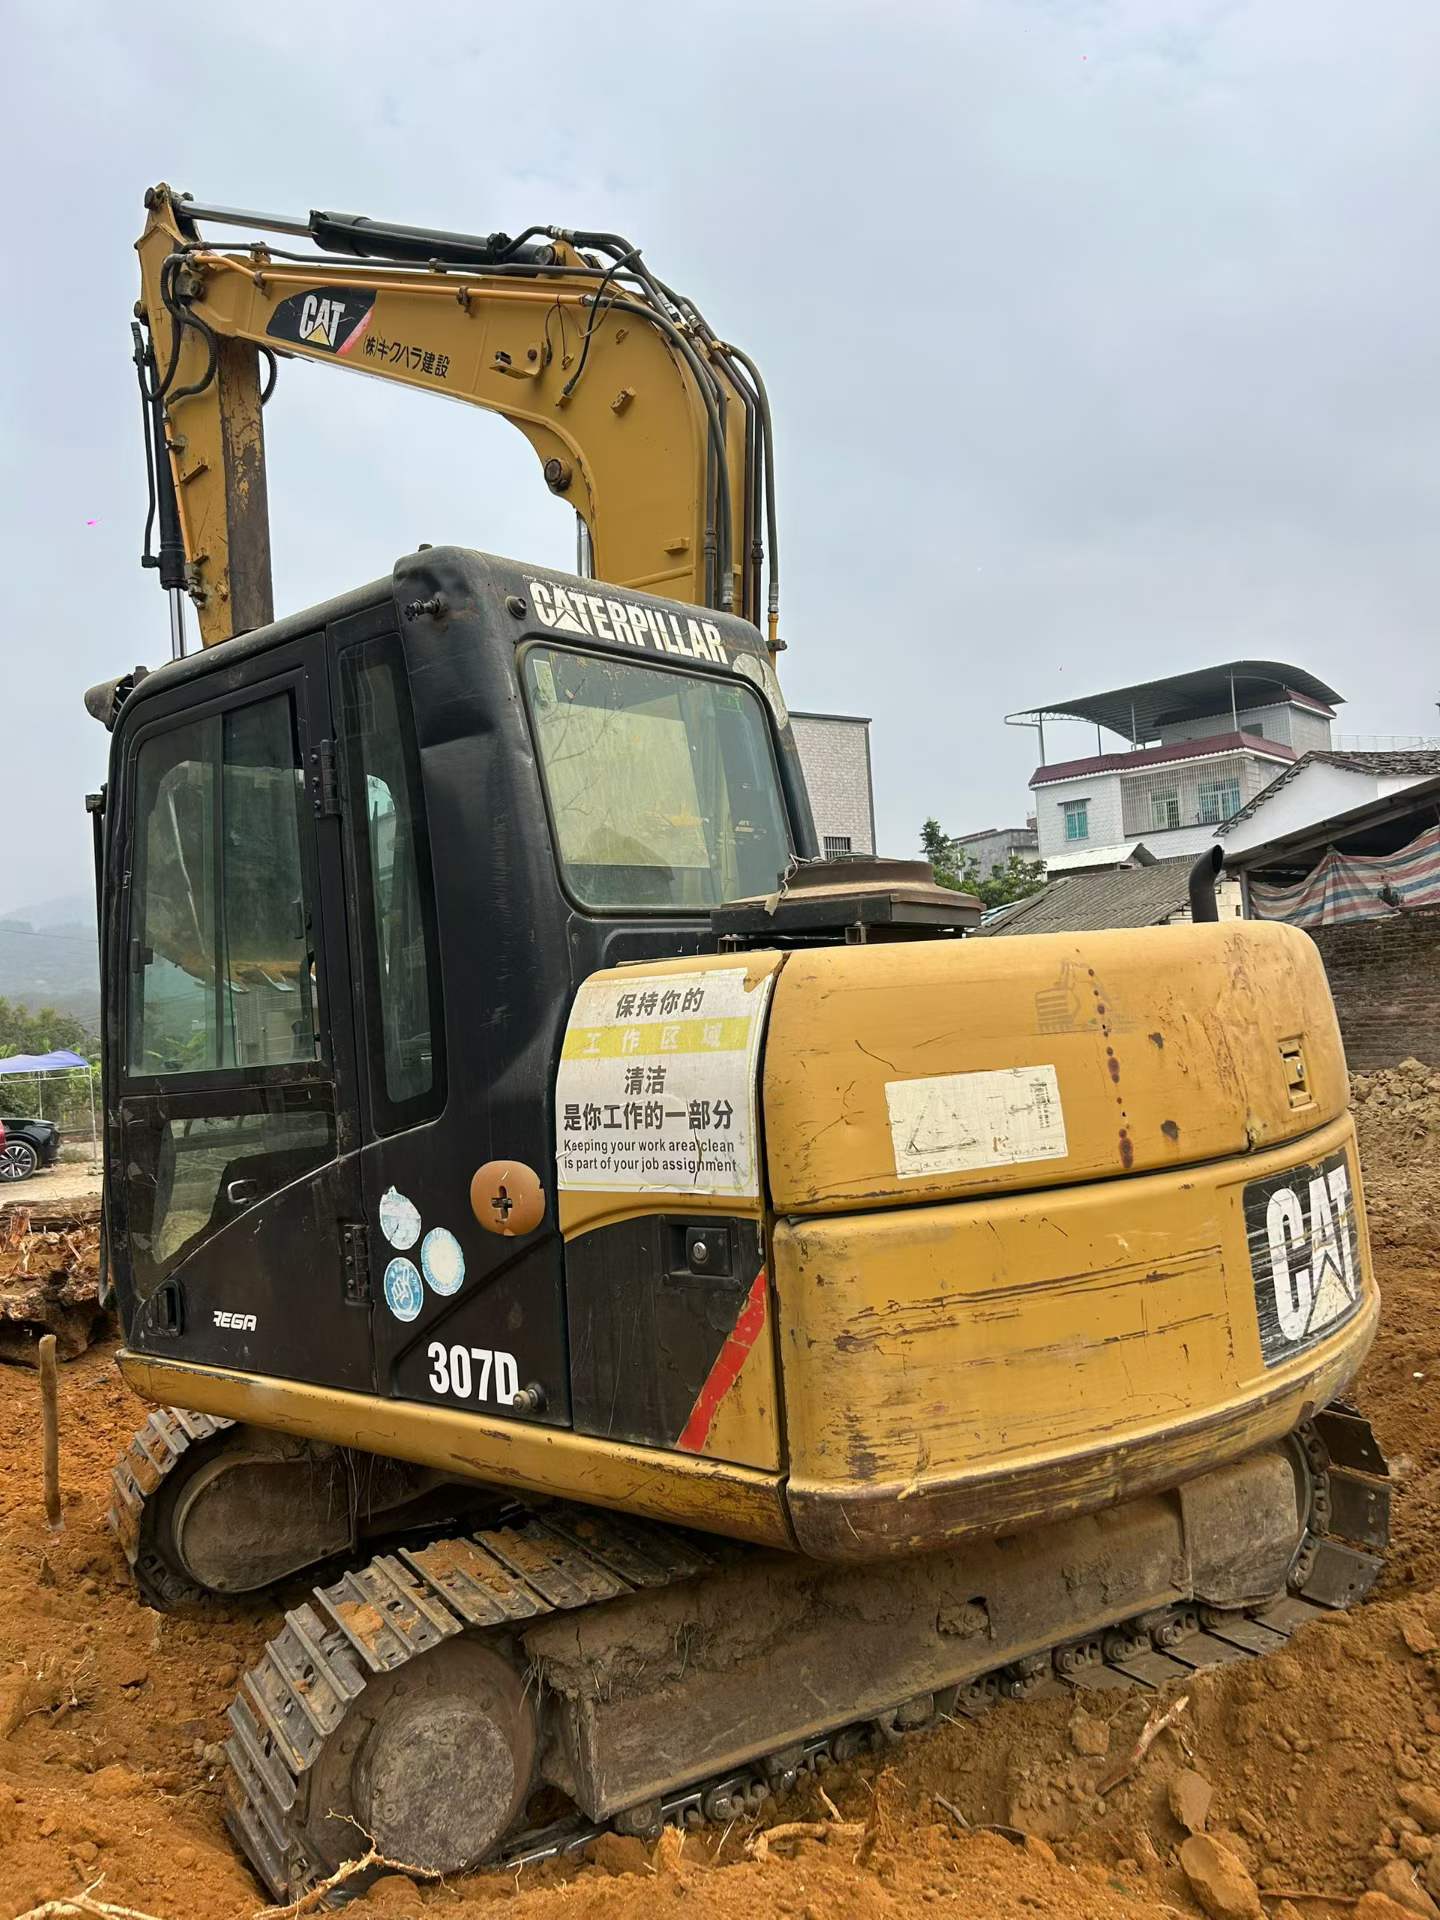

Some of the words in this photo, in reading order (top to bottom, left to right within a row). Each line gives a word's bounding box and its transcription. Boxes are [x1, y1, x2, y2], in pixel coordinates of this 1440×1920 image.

[299, 294, 346, 347] CAT
[529, 582, 730, 665] CATERPILLAR
[615, 987, 705, 1019] 保持你的
[582, 1022, 722, 1055] 工作区域
[623, 1064, 667, 1096] 清洁
[563, 1099, 734, 1131] 是你工作的一部分
[563, 1139, 608, 1154] Keeping
[610, 1140, 637, 1154] your
[638, 1139, 666, 1151] work
[668, 1139, 696, 1152] area
[701, 1139, 735, 1152] clean
[564, 1156, 574, 1169] is
[576, 1157, 598, 1172] part
[600, 1156, 612, 1169] of
[613, 1158, 639, 1172] your
[641, 1156, 660, 1173] job
[662, 1157, 737, 1174] assignment
[1266, 1164, 1357, 1341] CAT
[213, 1310, 257, 1332] REGA
[427, 1341, 519, 1406] 307D
